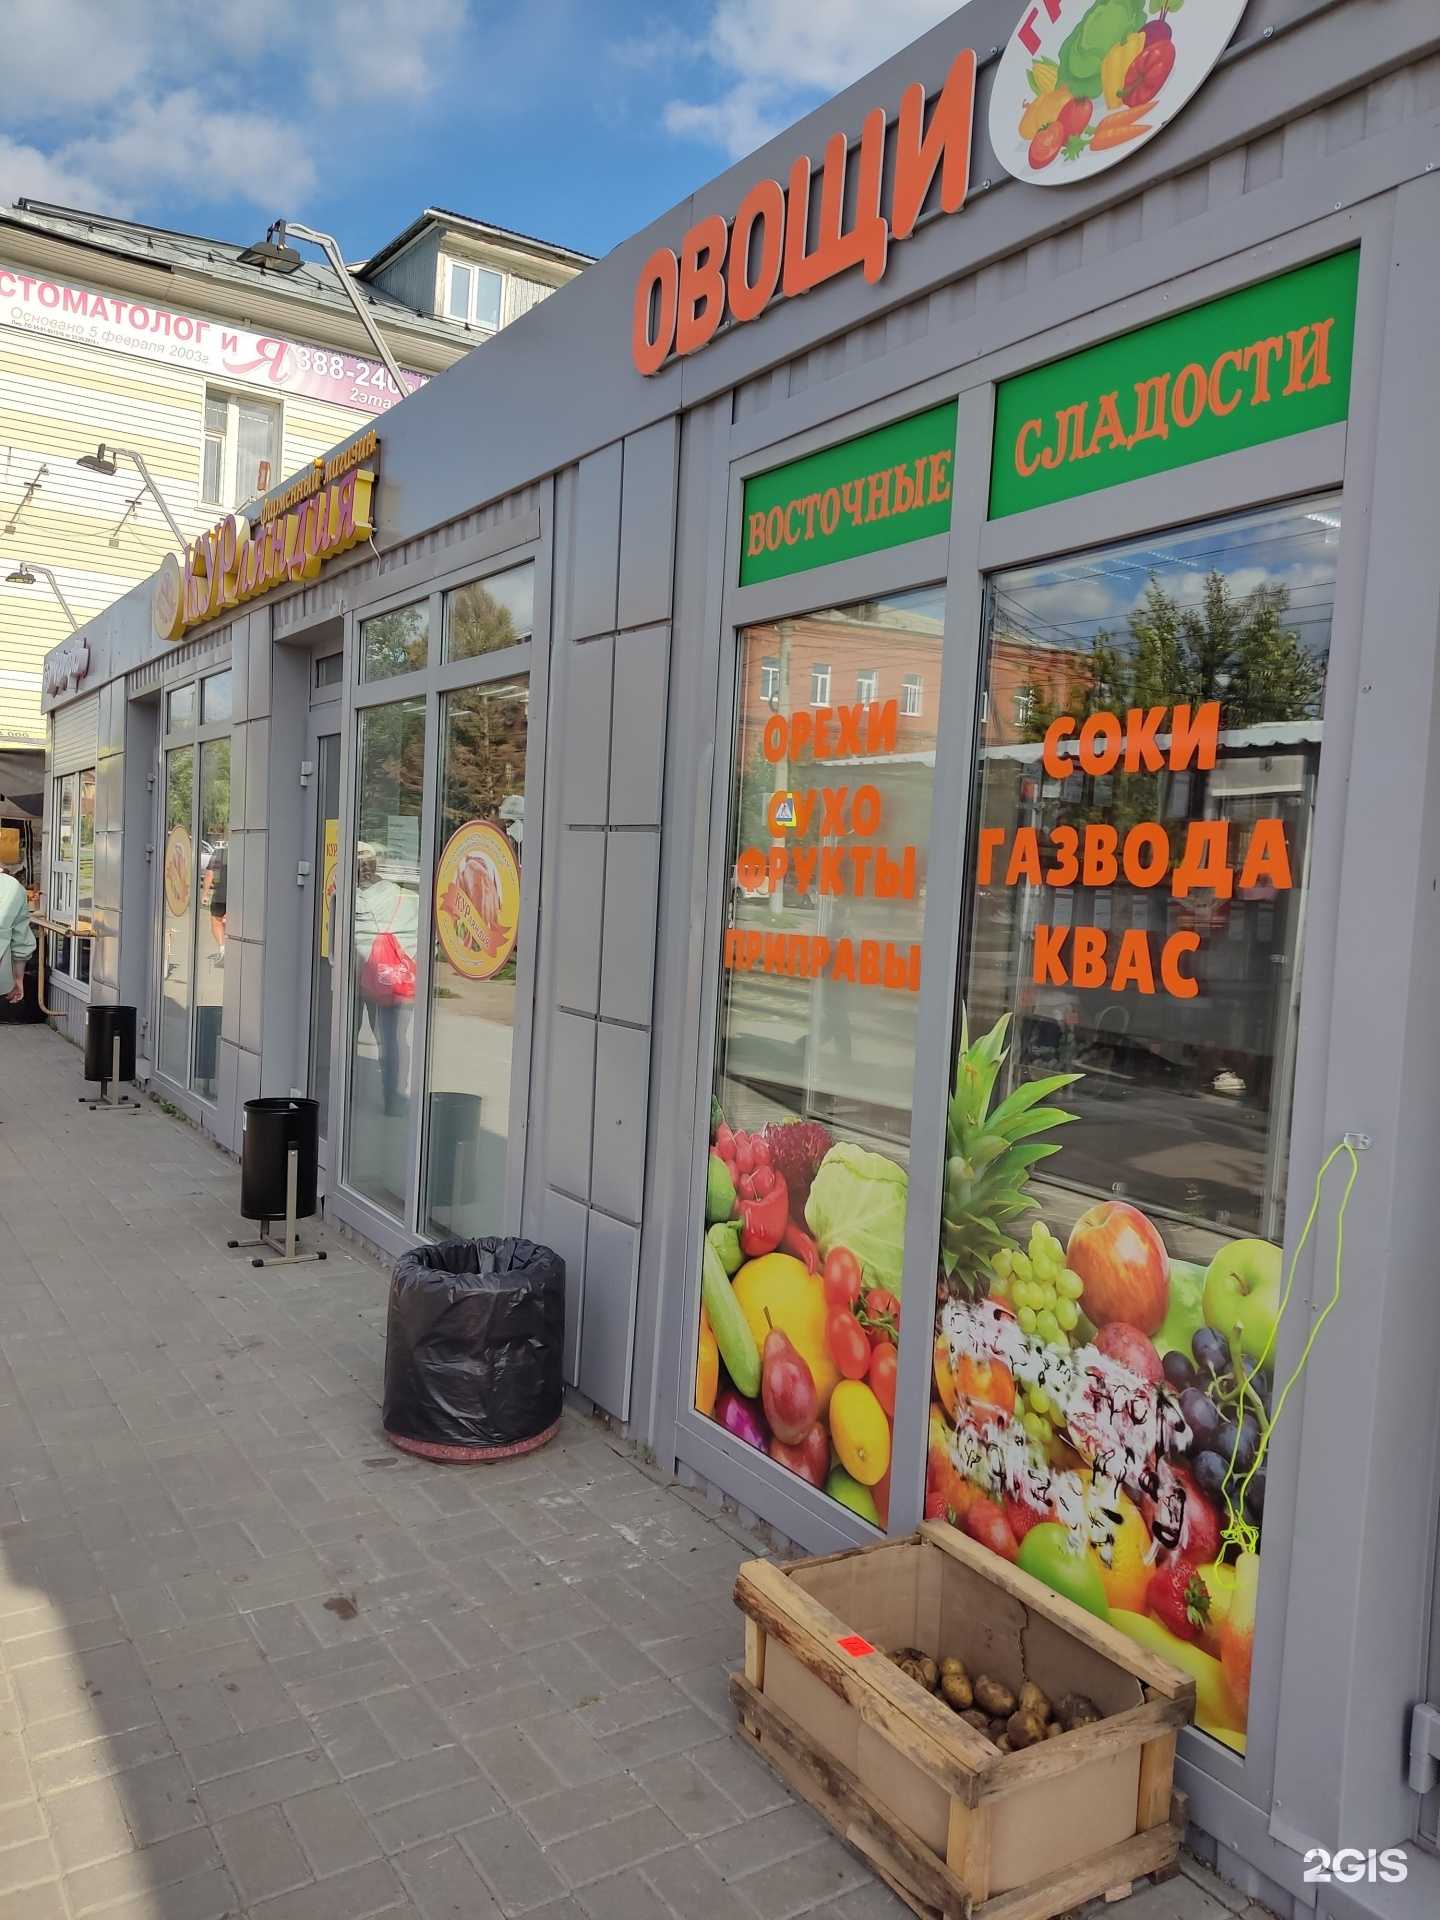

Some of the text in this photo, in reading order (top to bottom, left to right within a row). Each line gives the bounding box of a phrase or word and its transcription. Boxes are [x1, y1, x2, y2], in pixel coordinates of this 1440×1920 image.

[633, 48, 977, 376] ОВОЩИ
[0, 270, 210, 344] СТОМАТОЛОГ
[11, 306, 85, 336] Основано
[88, 326, 99, 338] 5
[101, 329, 165, 354] февраля
[1015, 318, 1335, 478] СЛАДОСТИ
[747, 450, 951, 558] ВОСТОЧНЫЕ
[763, 699, 897, 764] ОРЕХИ
[1042, 700, 1221, 779] СОКИ
[768, 784, 881, 839] СУХО
[736, 845, 917, 900] ФРУКТЫ
[976, 818, 1293, 900] ГАЗВОДА
[724, 928, 921, 992] ПРИПРАВЫ
[1032, 922, 1201, 1000] КВАС
